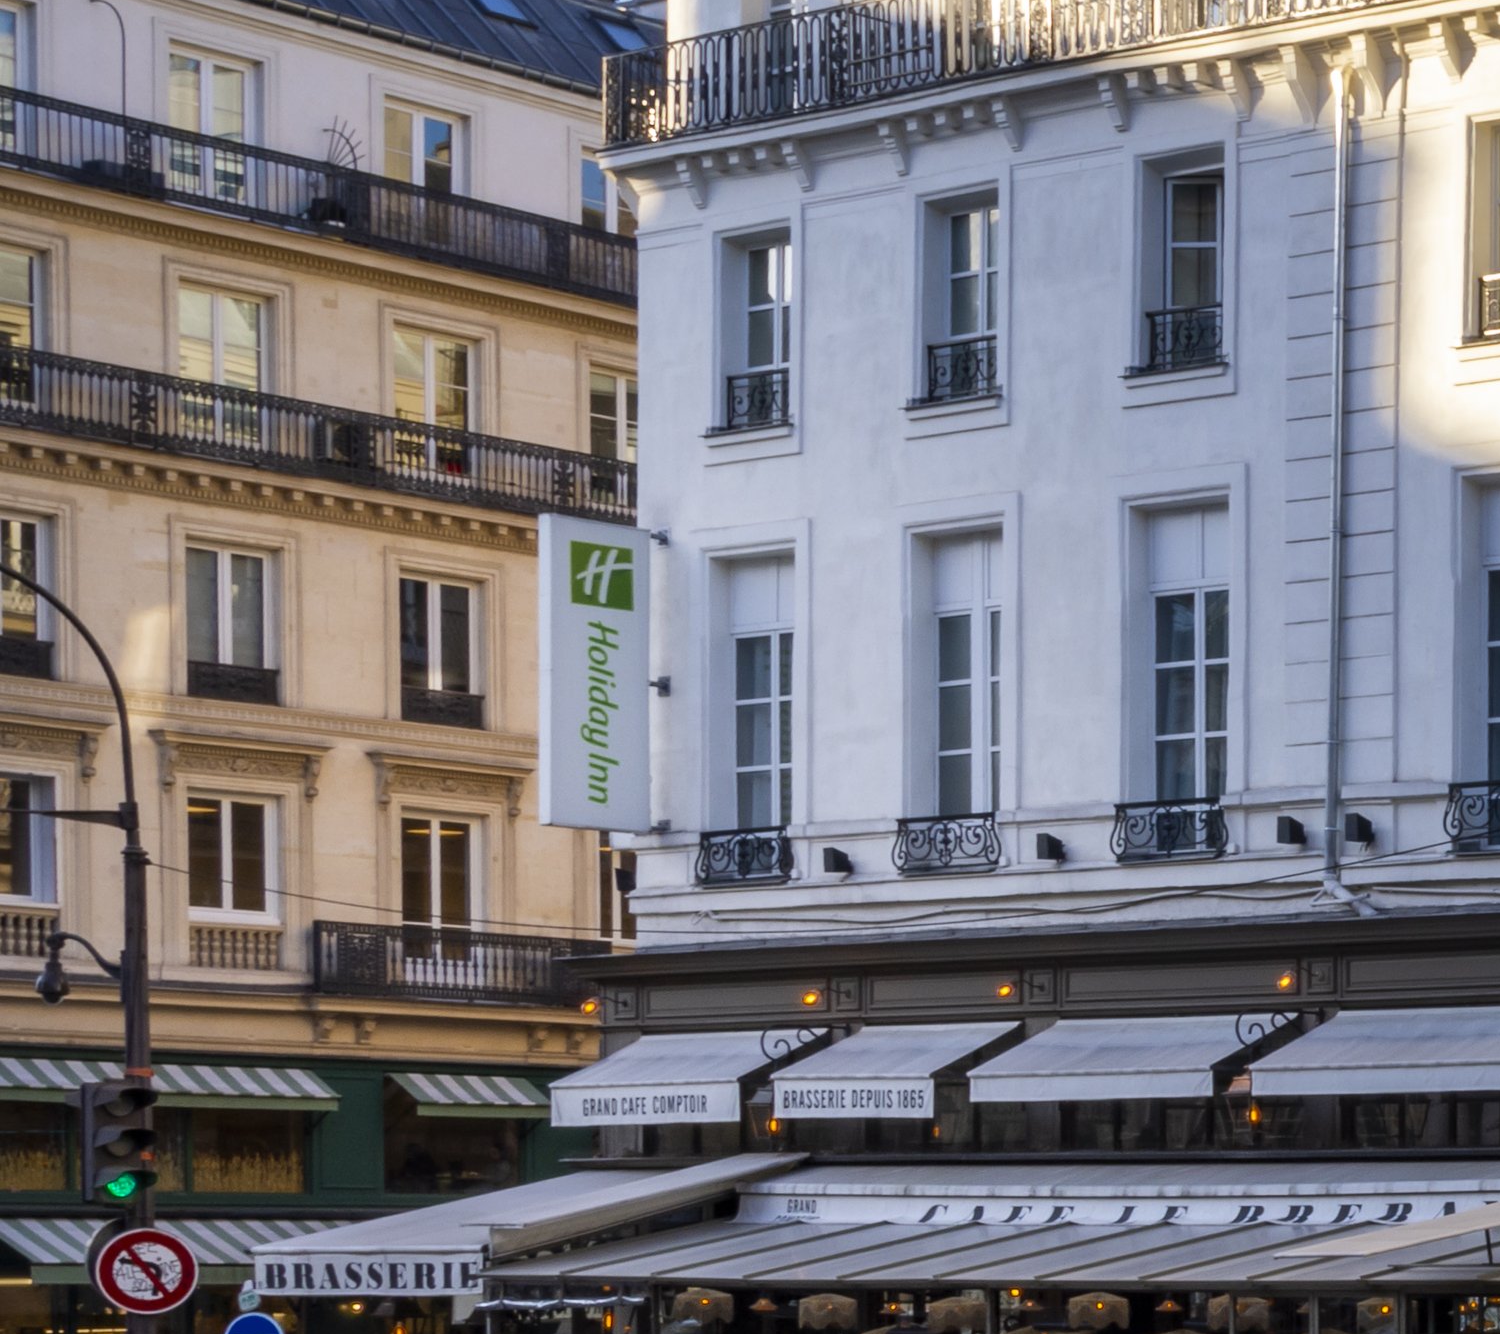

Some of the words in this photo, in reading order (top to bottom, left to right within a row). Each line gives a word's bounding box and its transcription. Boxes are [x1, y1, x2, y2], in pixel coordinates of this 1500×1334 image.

[580, 620, 619, 749] Holiday
[588, 753, 619, 805] Inn
[582, 1096, 618, 1116] GRAND
[621, 1096, 647, 1115] CAFE
[652, 1095, 707, 1114] COMPTOIR
[783, 1089, 846, 1109] BRASSERIE
[851, 1089, 893, 1109] DEPUIS
[896, 1089, 925, 1109] 1865
[787, 1198, 816, 1214] GRAND
[264, 1261, 480, 1290] BRASSERIE
